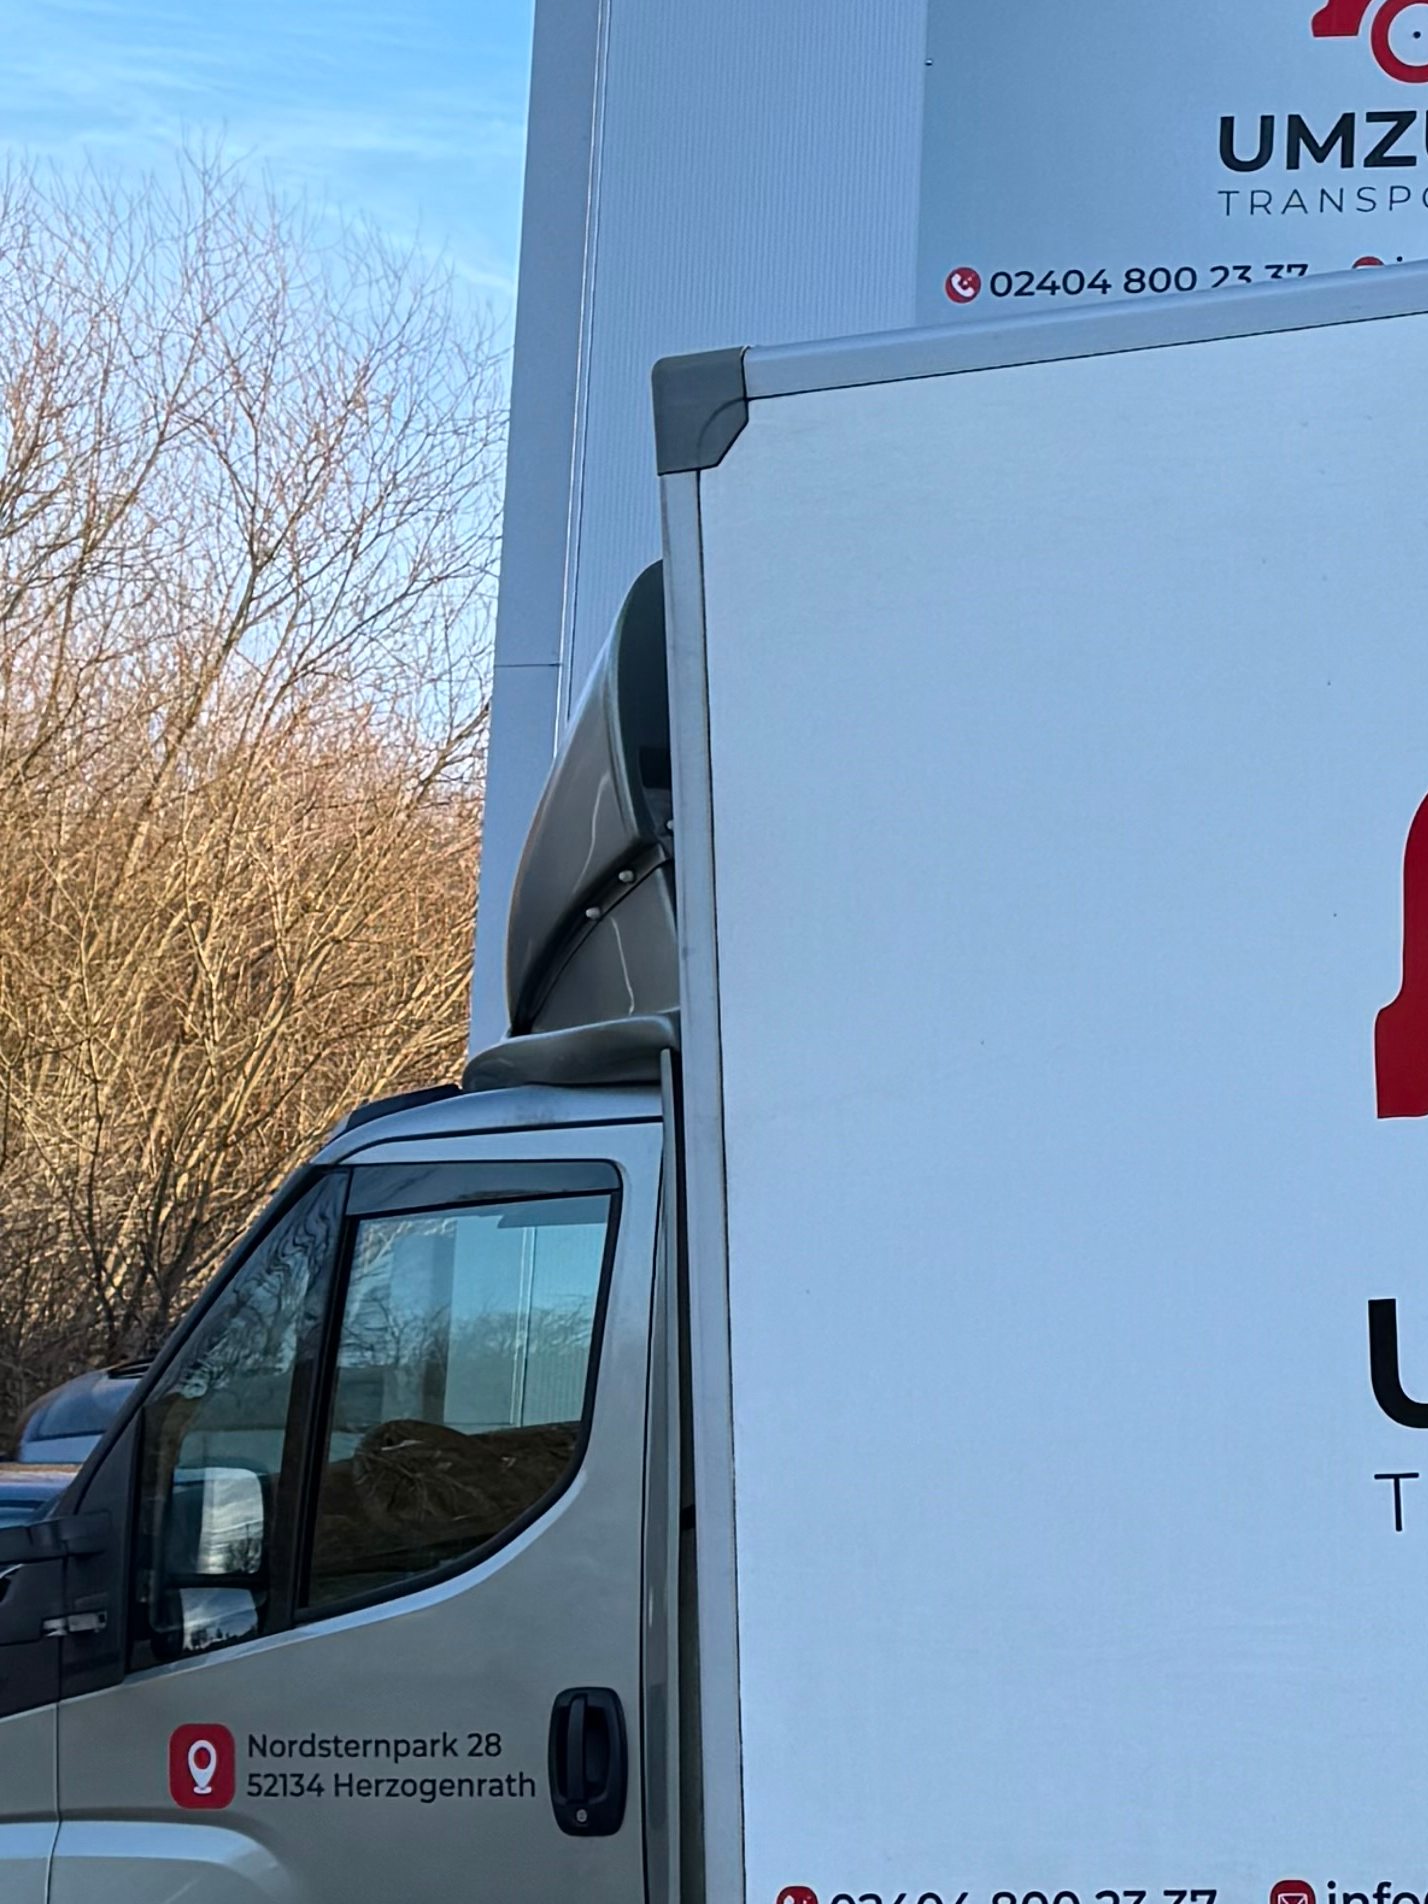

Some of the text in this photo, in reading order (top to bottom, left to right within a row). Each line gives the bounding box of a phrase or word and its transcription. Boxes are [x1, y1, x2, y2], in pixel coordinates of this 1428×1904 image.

[990, 268, 1112, 298] 02404
[1123, 266, 1197, 294] 800
[248, 1731, 502, 1764] Nordsternpark 28
[247, 1771, 536, 1804] 52134 Herzogenrath
